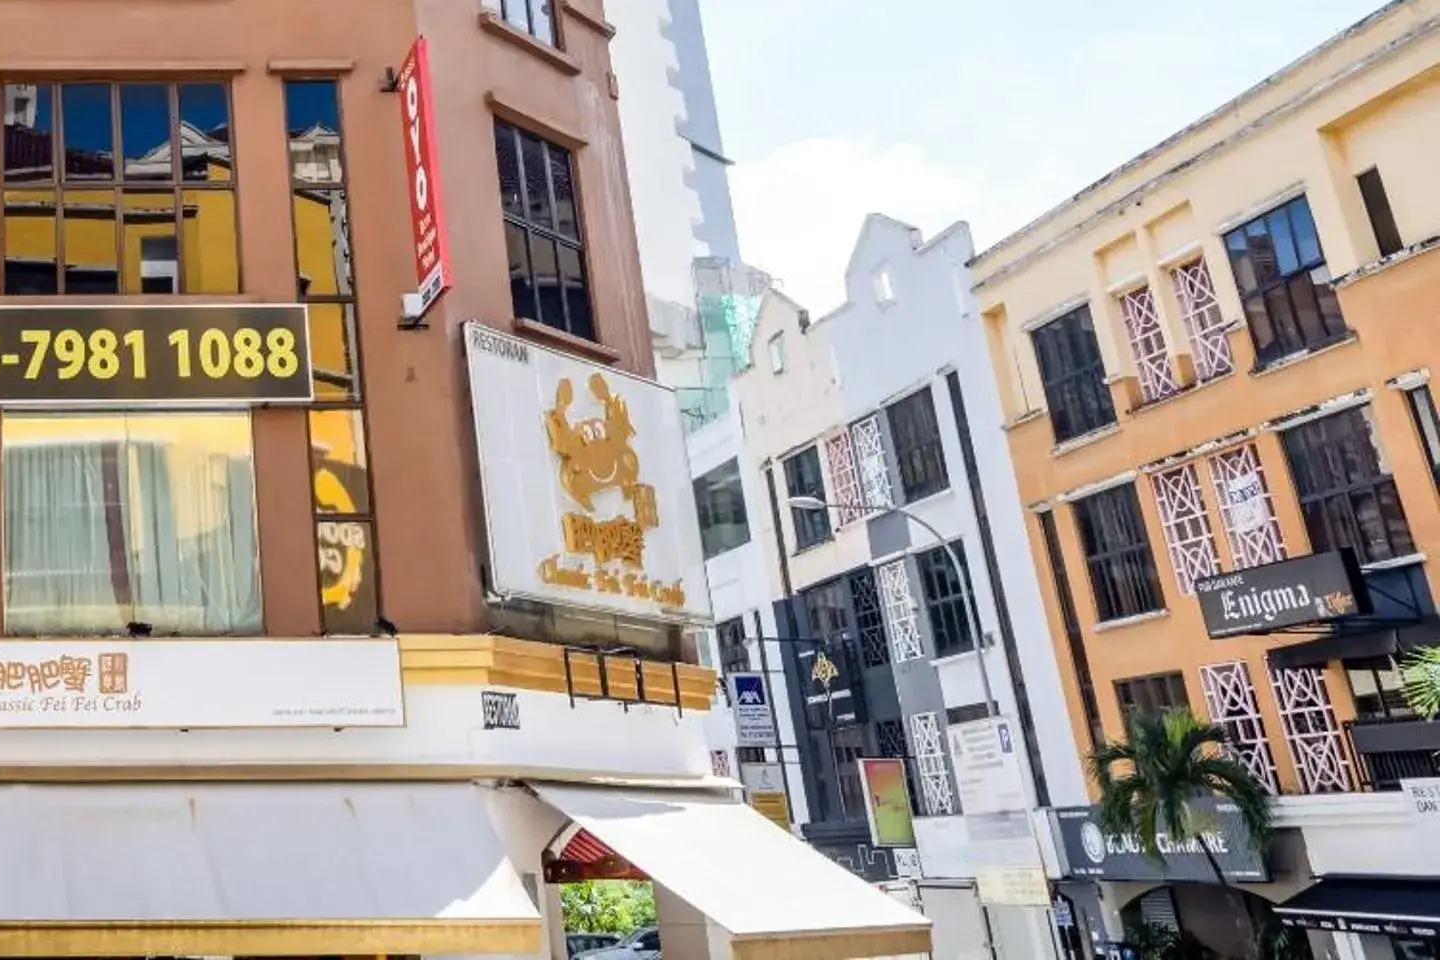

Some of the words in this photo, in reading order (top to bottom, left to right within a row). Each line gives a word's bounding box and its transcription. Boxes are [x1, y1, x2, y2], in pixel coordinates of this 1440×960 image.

[406, 76, 427, 211] OYO
[168, 328, 299, 379] 1088
[1221, 583, 1311, 622] Enigma
[41, 695, 66, 713] Fei
[74, 695, 97, 713] Fei
[103, 692, 142, 713] Crab
[739, 690, 761, 704] AXA
